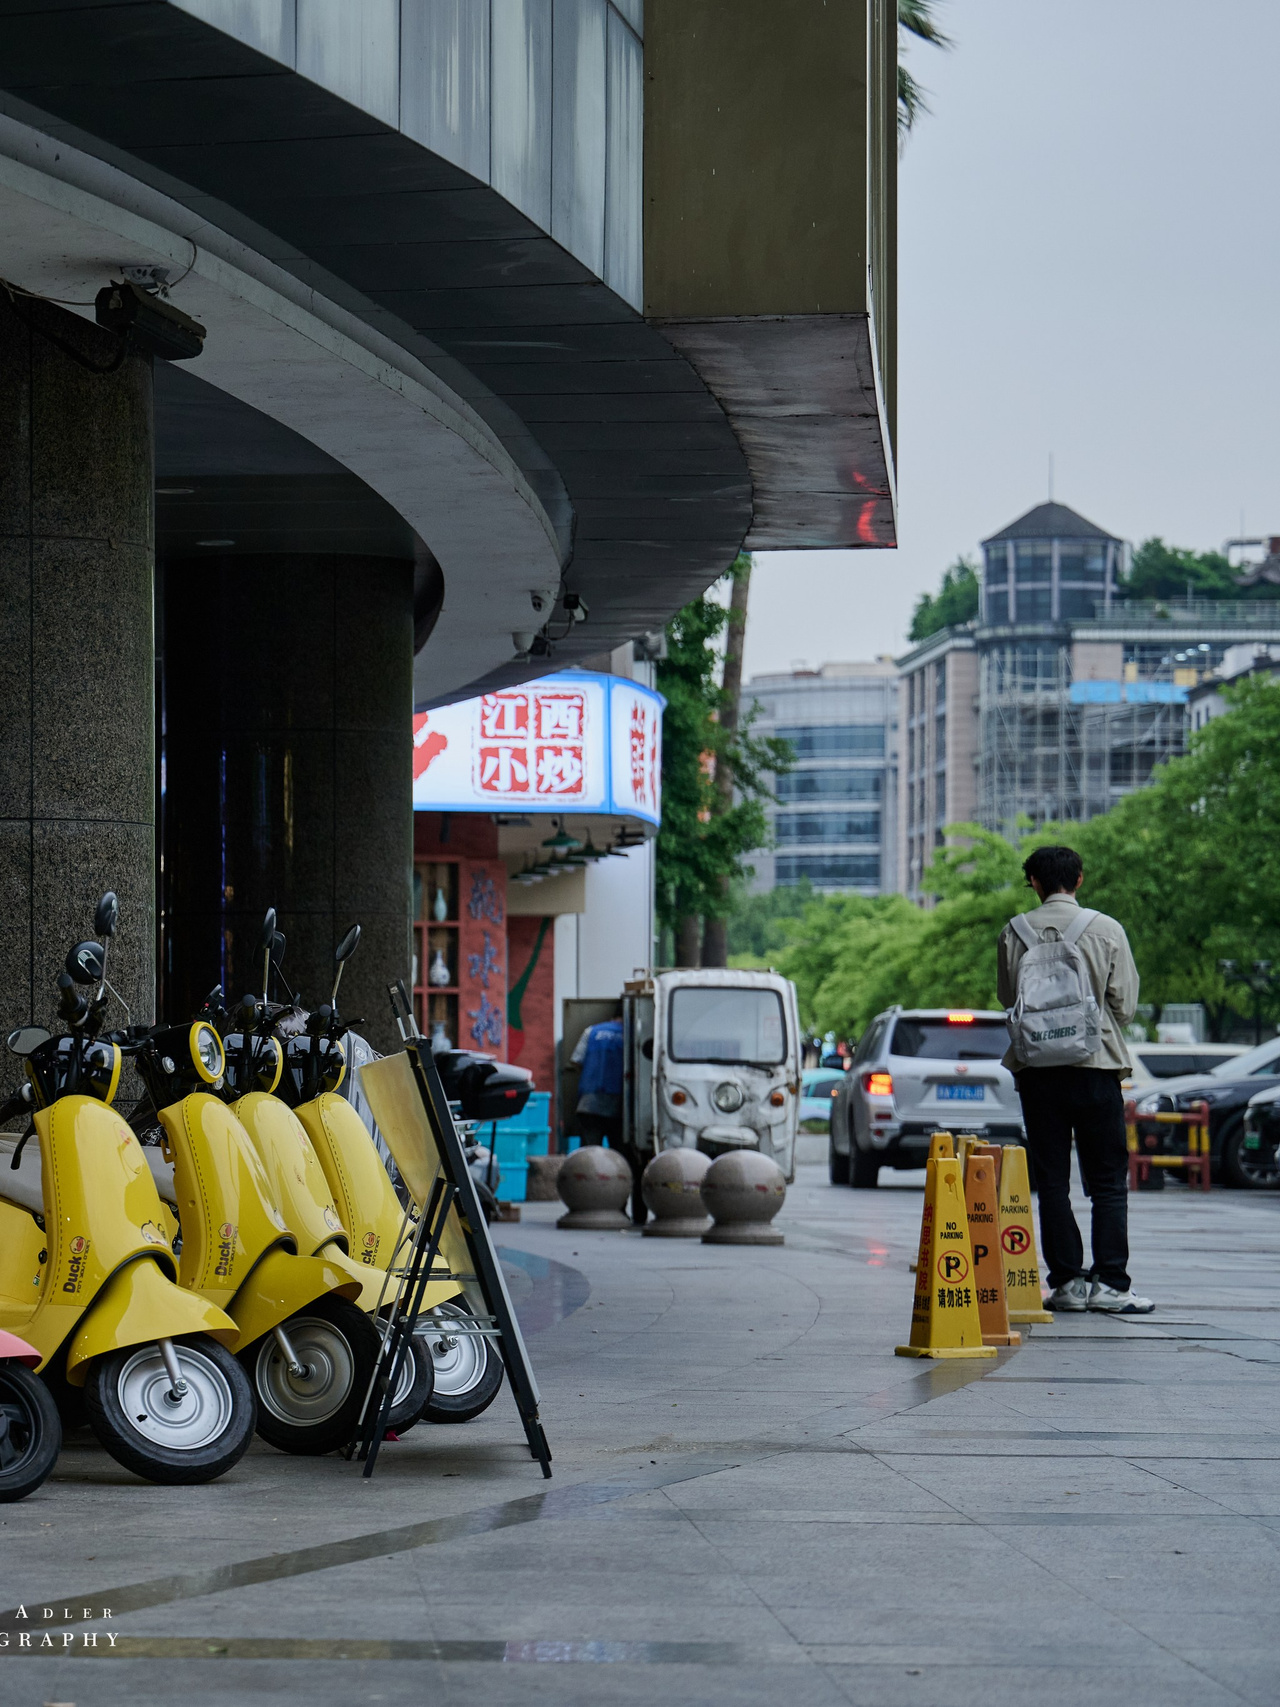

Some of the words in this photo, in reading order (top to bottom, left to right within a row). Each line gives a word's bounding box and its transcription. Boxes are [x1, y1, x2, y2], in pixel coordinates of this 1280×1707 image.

[481, 694, 584, 740] 江西
[481, 746, 584, 793] 小炒
[1031, 1025, 1077, 1042] SKECHERS
[974, 1202, 986, 1211] NO
[1010, 1195, 1019, 1203] NO
[1001, 1205, 1028, 1214] PARKING
[946, 1222, 957, 1230] NO
[967, 1214, 993, 1222] PARKING
[214, 1241, 232, 1276] Duck
[361, 1249, 374, 1265] ck
[62, 1256, 83, 1294] Duck
[938, 1287, 971, 1308] 请勿泊车
